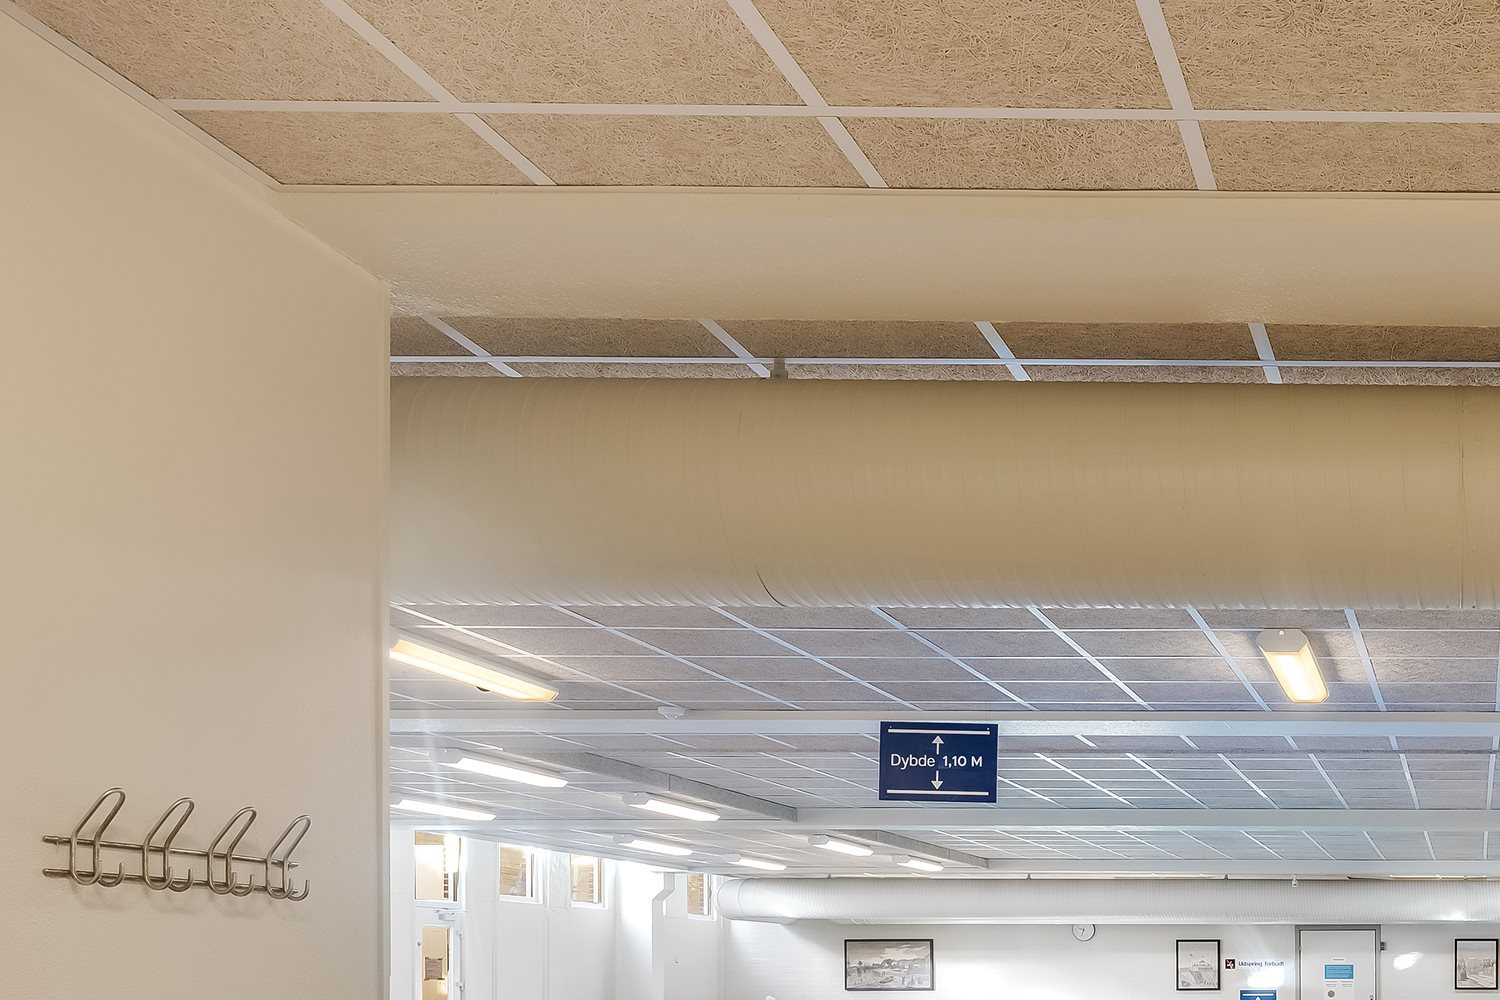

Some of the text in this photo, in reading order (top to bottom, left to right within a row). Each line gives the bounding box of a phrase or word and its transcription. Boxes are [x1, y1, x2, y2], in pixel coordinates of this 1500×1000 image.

[890, 753, 983, 770] Dybde 1,10 M
